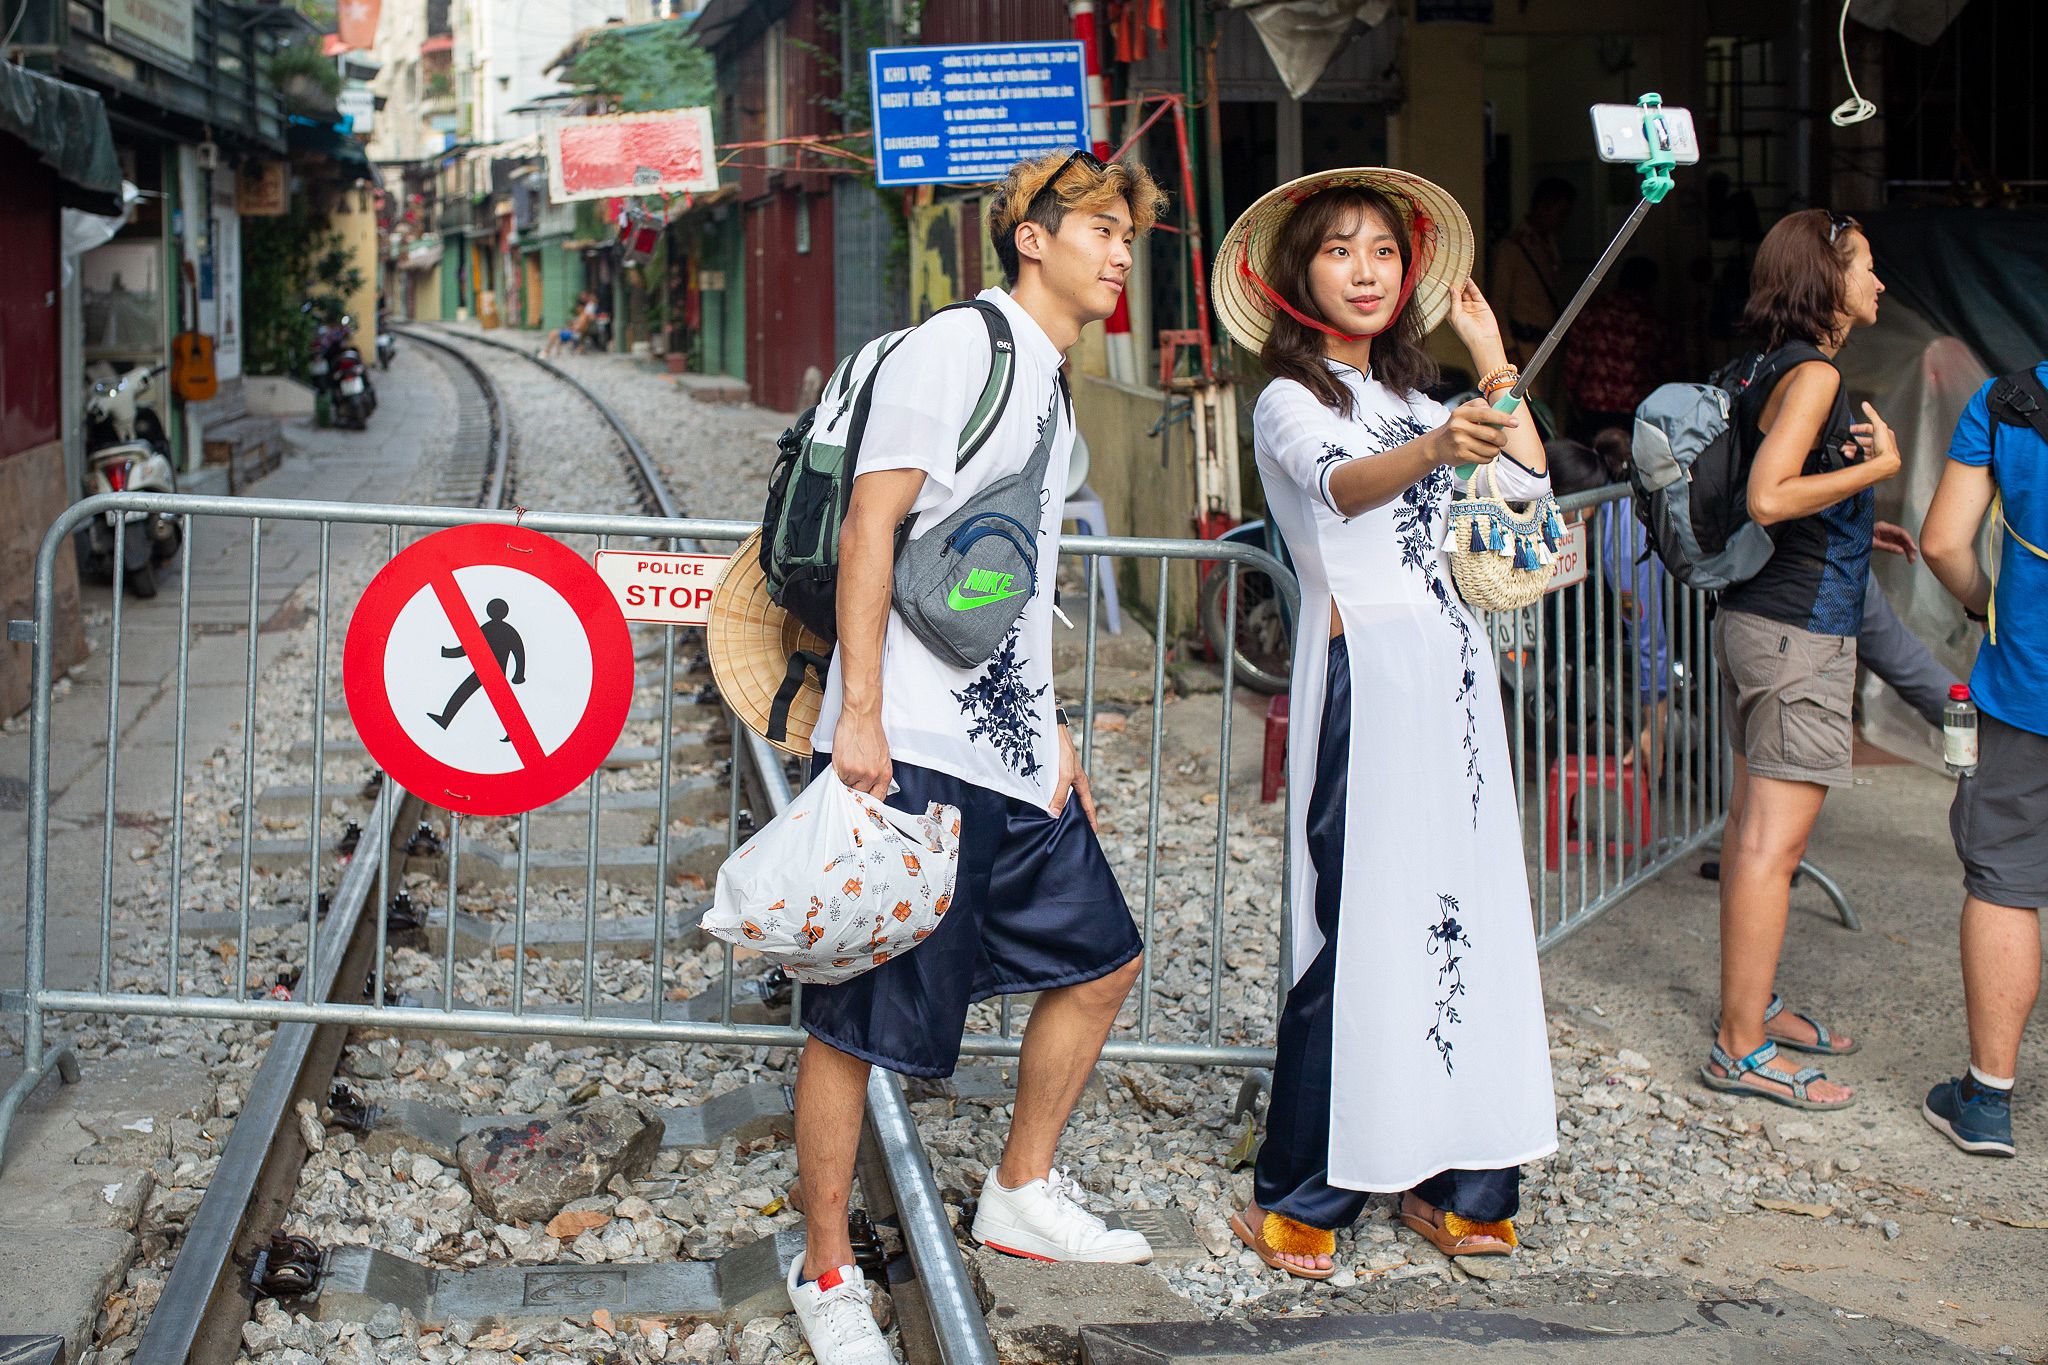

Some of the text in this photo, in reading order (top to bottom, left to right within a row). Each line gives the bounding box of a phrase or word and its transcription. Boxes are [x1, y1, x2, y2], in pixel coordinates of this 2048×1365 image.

[637, 561, 704, 576] POLICE
[963, 567, 1014, 594] NIKE
[625, 585, 713, 609] STOP
